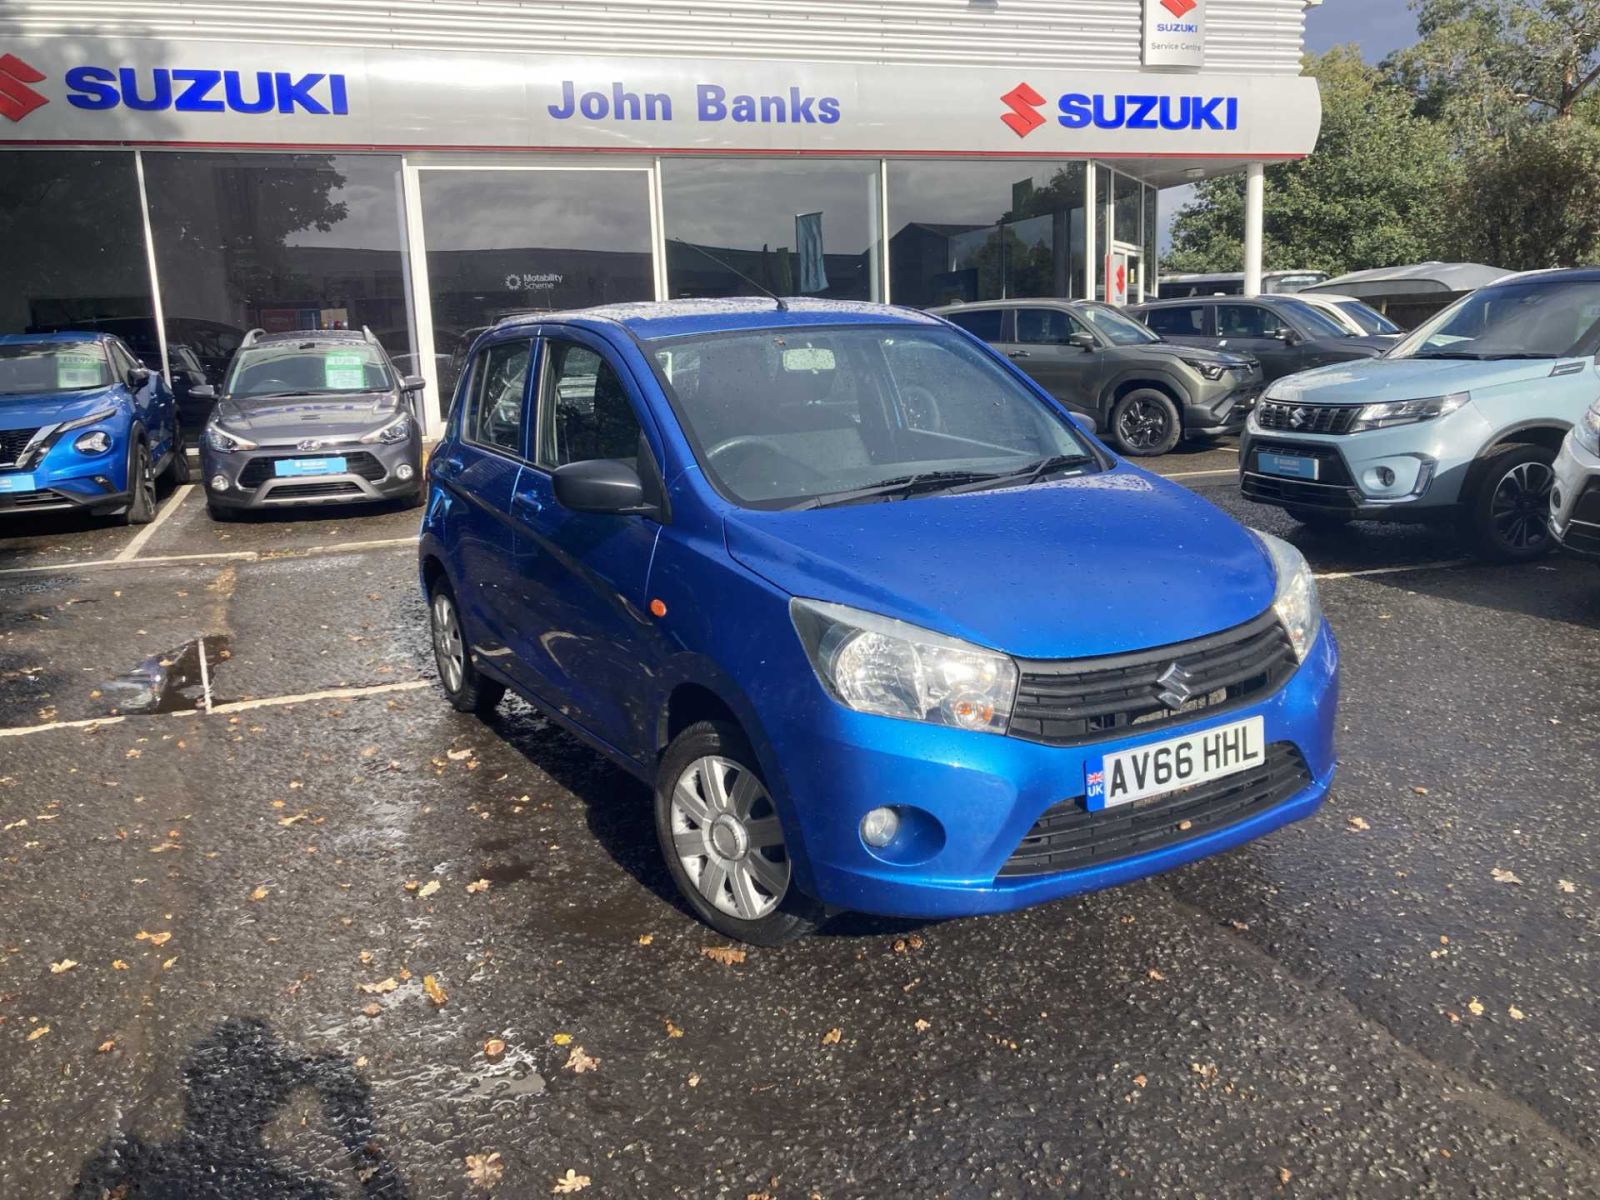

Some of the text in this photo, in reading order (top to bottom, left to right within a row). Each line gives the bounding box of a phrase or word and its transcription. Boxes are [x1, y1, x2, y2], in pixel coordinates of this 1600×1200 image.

[1157, 24, 1198, 33] SUZUKI
[1151, 42, 1179, 50] Service
[65, 66, 349, 116] SUZUKI
[547, 80, 841, 125] John Banks
[1058, 93, 1238, 131] SUZUKI
[523, 273, 563, 283] Motability
[1109, 725, 1259, 798] AV66 HHL
[1087, 783, 1104, 797] UK
